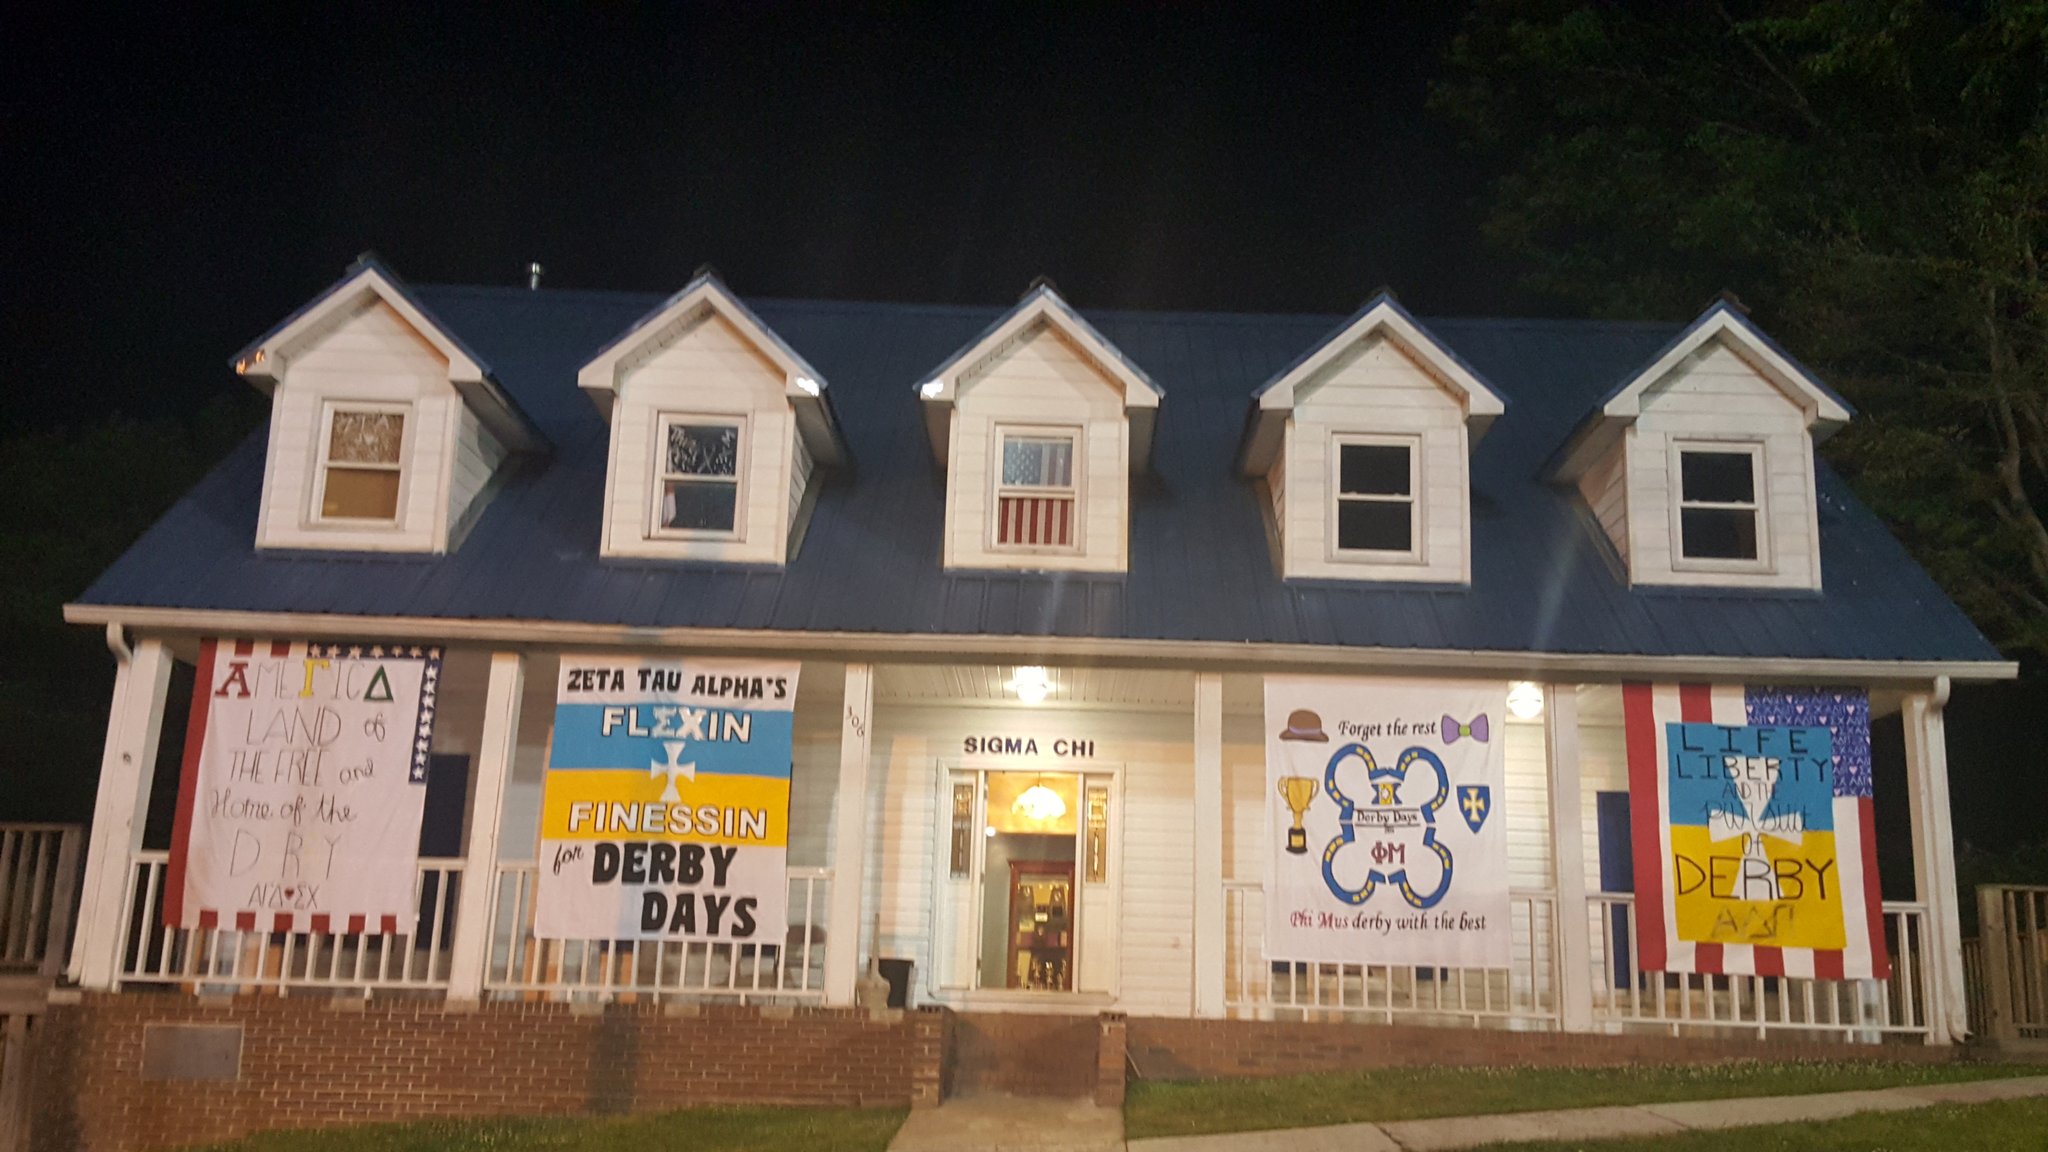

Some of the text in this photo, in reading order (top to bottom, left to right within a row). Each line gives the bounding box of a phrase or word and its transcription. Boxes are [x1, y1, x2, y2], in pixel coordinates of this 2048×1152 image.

[567, 668, 787, 699] ZETA TAU ALPHA'S
[246, 705, 386, 747] LAND of
[1338, 717, 1437, 742] Forget the rest
[1680, 724, 1809, 754] LIFE
[963, 736, 1096, 757] SIGMA CHI
[229, 748, 374, 787] THE FREE and
[1677, 754, 1832, 783] LIBERTY
[1721, 781, 1752, 801] AND
[210, 787, 358, 828] Home of the
[568, 800, 768, 840] FINESSIN
[1356, 809, 1418, 829] Derby Days
[1741, 831, 1769, 858] OF
[553, 843, 738, 887] for DERBY
[1675, 854, 1834, 901] DERBY
[640, 891, 758, 938] DAYS
[1289, 910, 1487, 937] Phi Mus derby with the best
